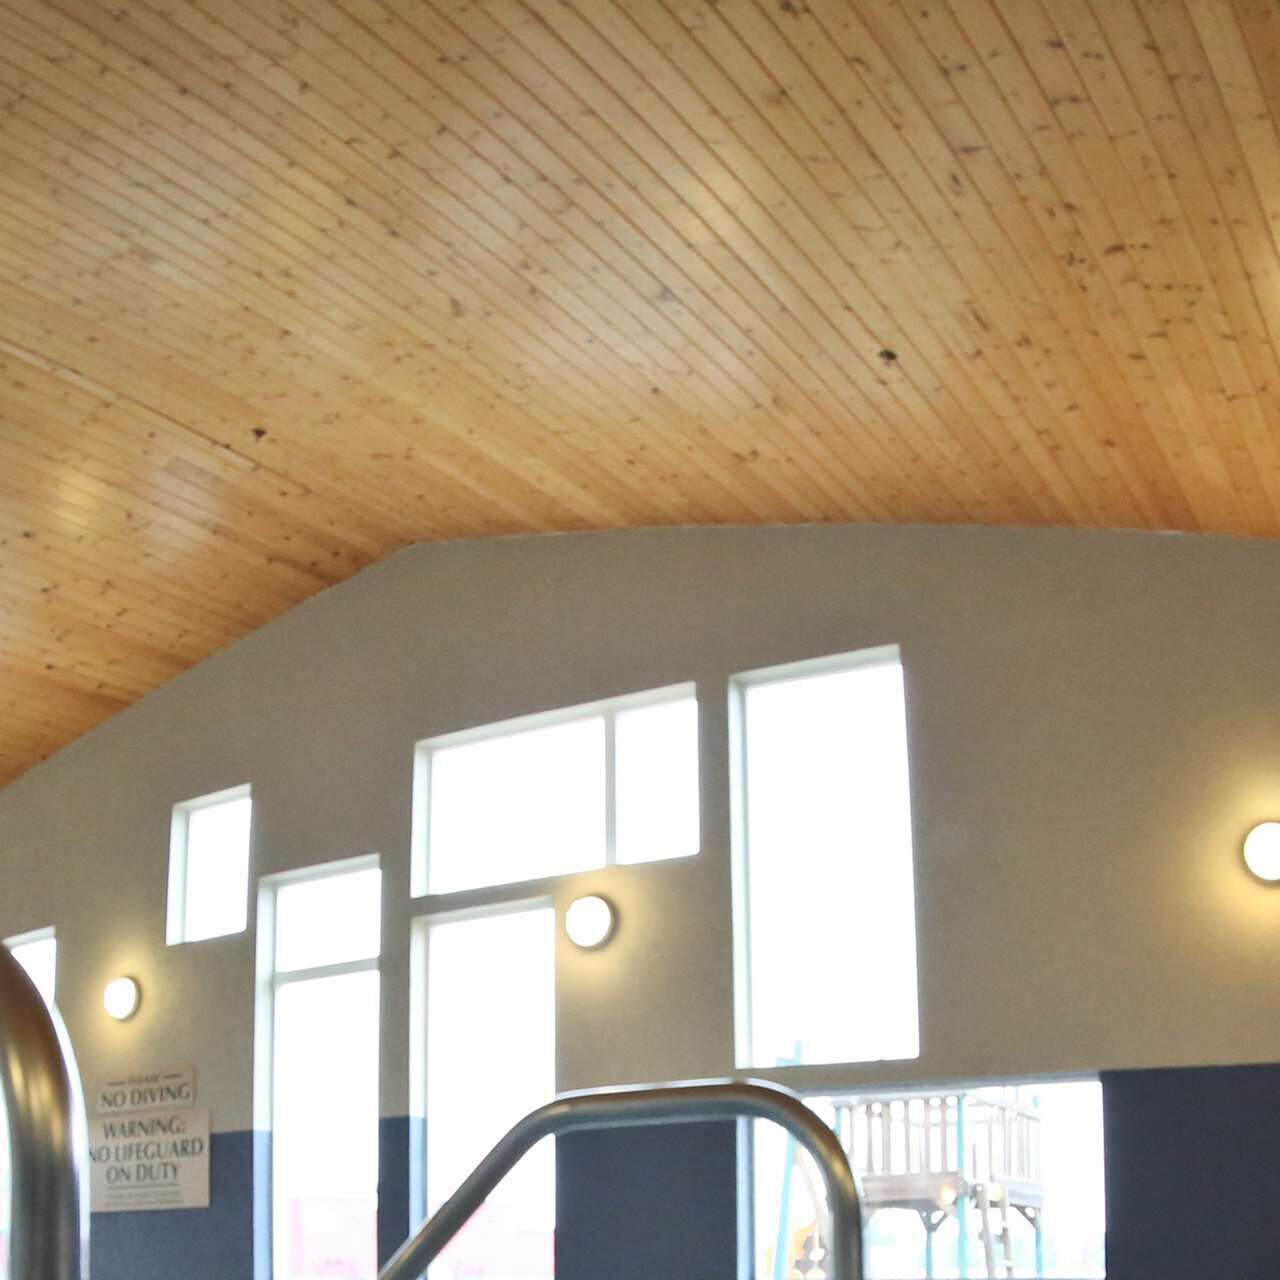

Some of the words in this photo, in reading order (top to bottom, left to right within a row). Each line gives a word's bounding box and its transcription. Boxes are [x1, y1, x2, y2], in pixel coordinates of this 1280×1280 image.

[102, 1092, 126, 1108] NO
[131, 1083, 190, 1104] DIVING
[115, 1138, 204, 1162] LIFEGUARD
[106, 1166, 130, 1183] ON
[136, 1161, 178, 1182] DUTY
